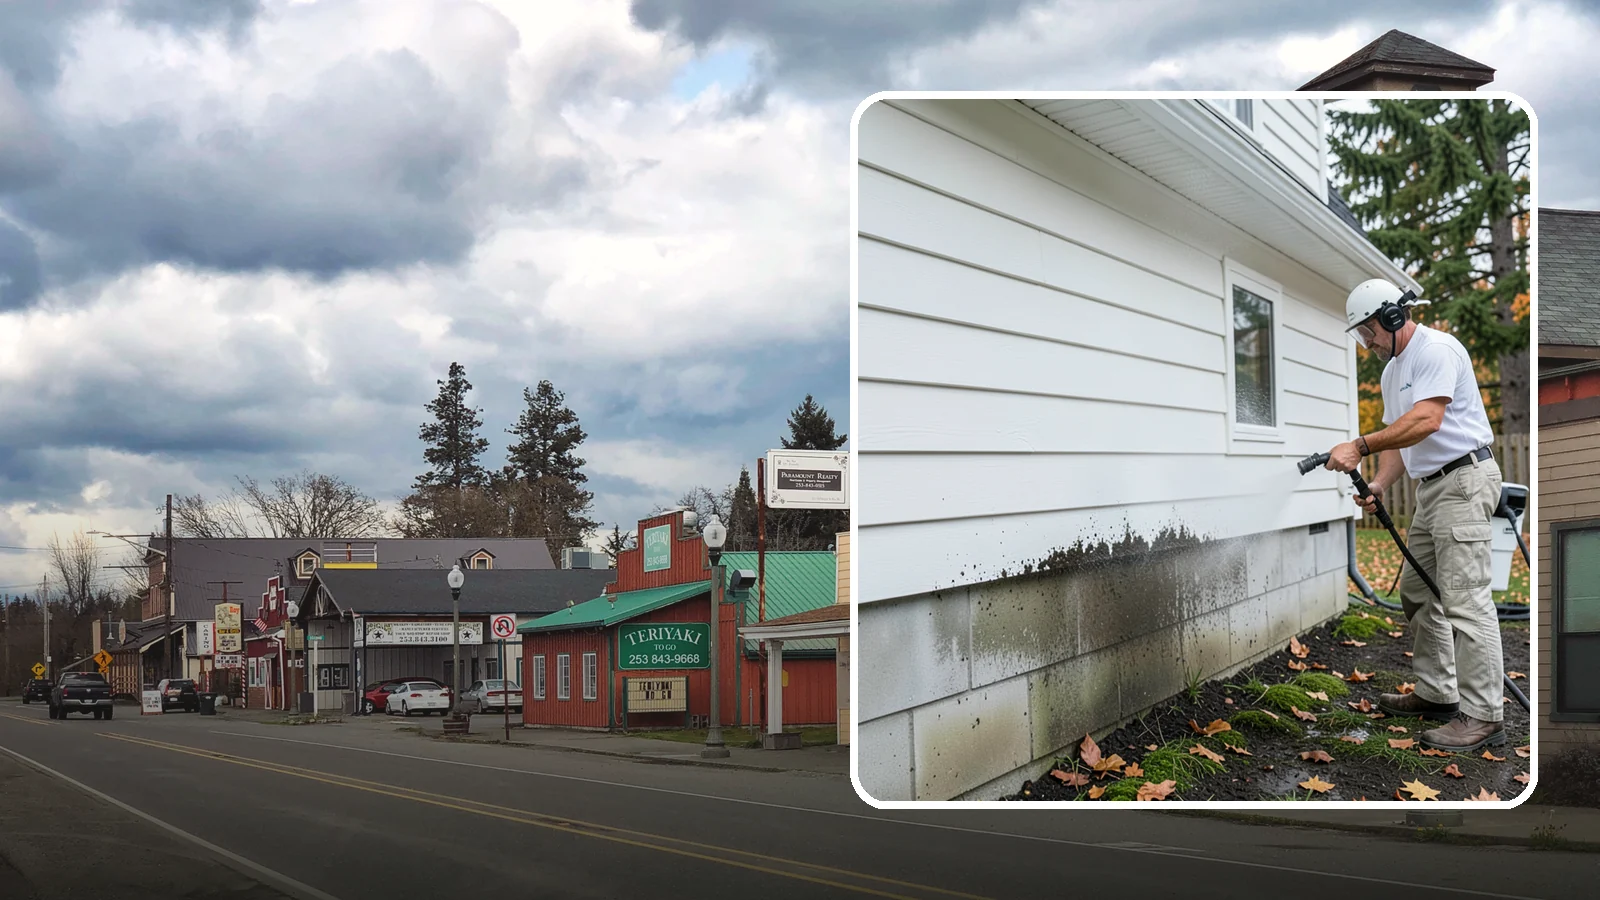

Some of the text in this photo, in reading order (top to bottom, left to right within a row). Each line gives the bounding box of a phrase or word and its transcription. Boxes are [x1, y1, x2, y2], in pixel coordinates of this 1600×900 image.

[625, 627, 702, 646] TERIYAKI
[629, 654, 700, 664] 253 843-9668
[639, 681, 672, 691] TERIYAKI
